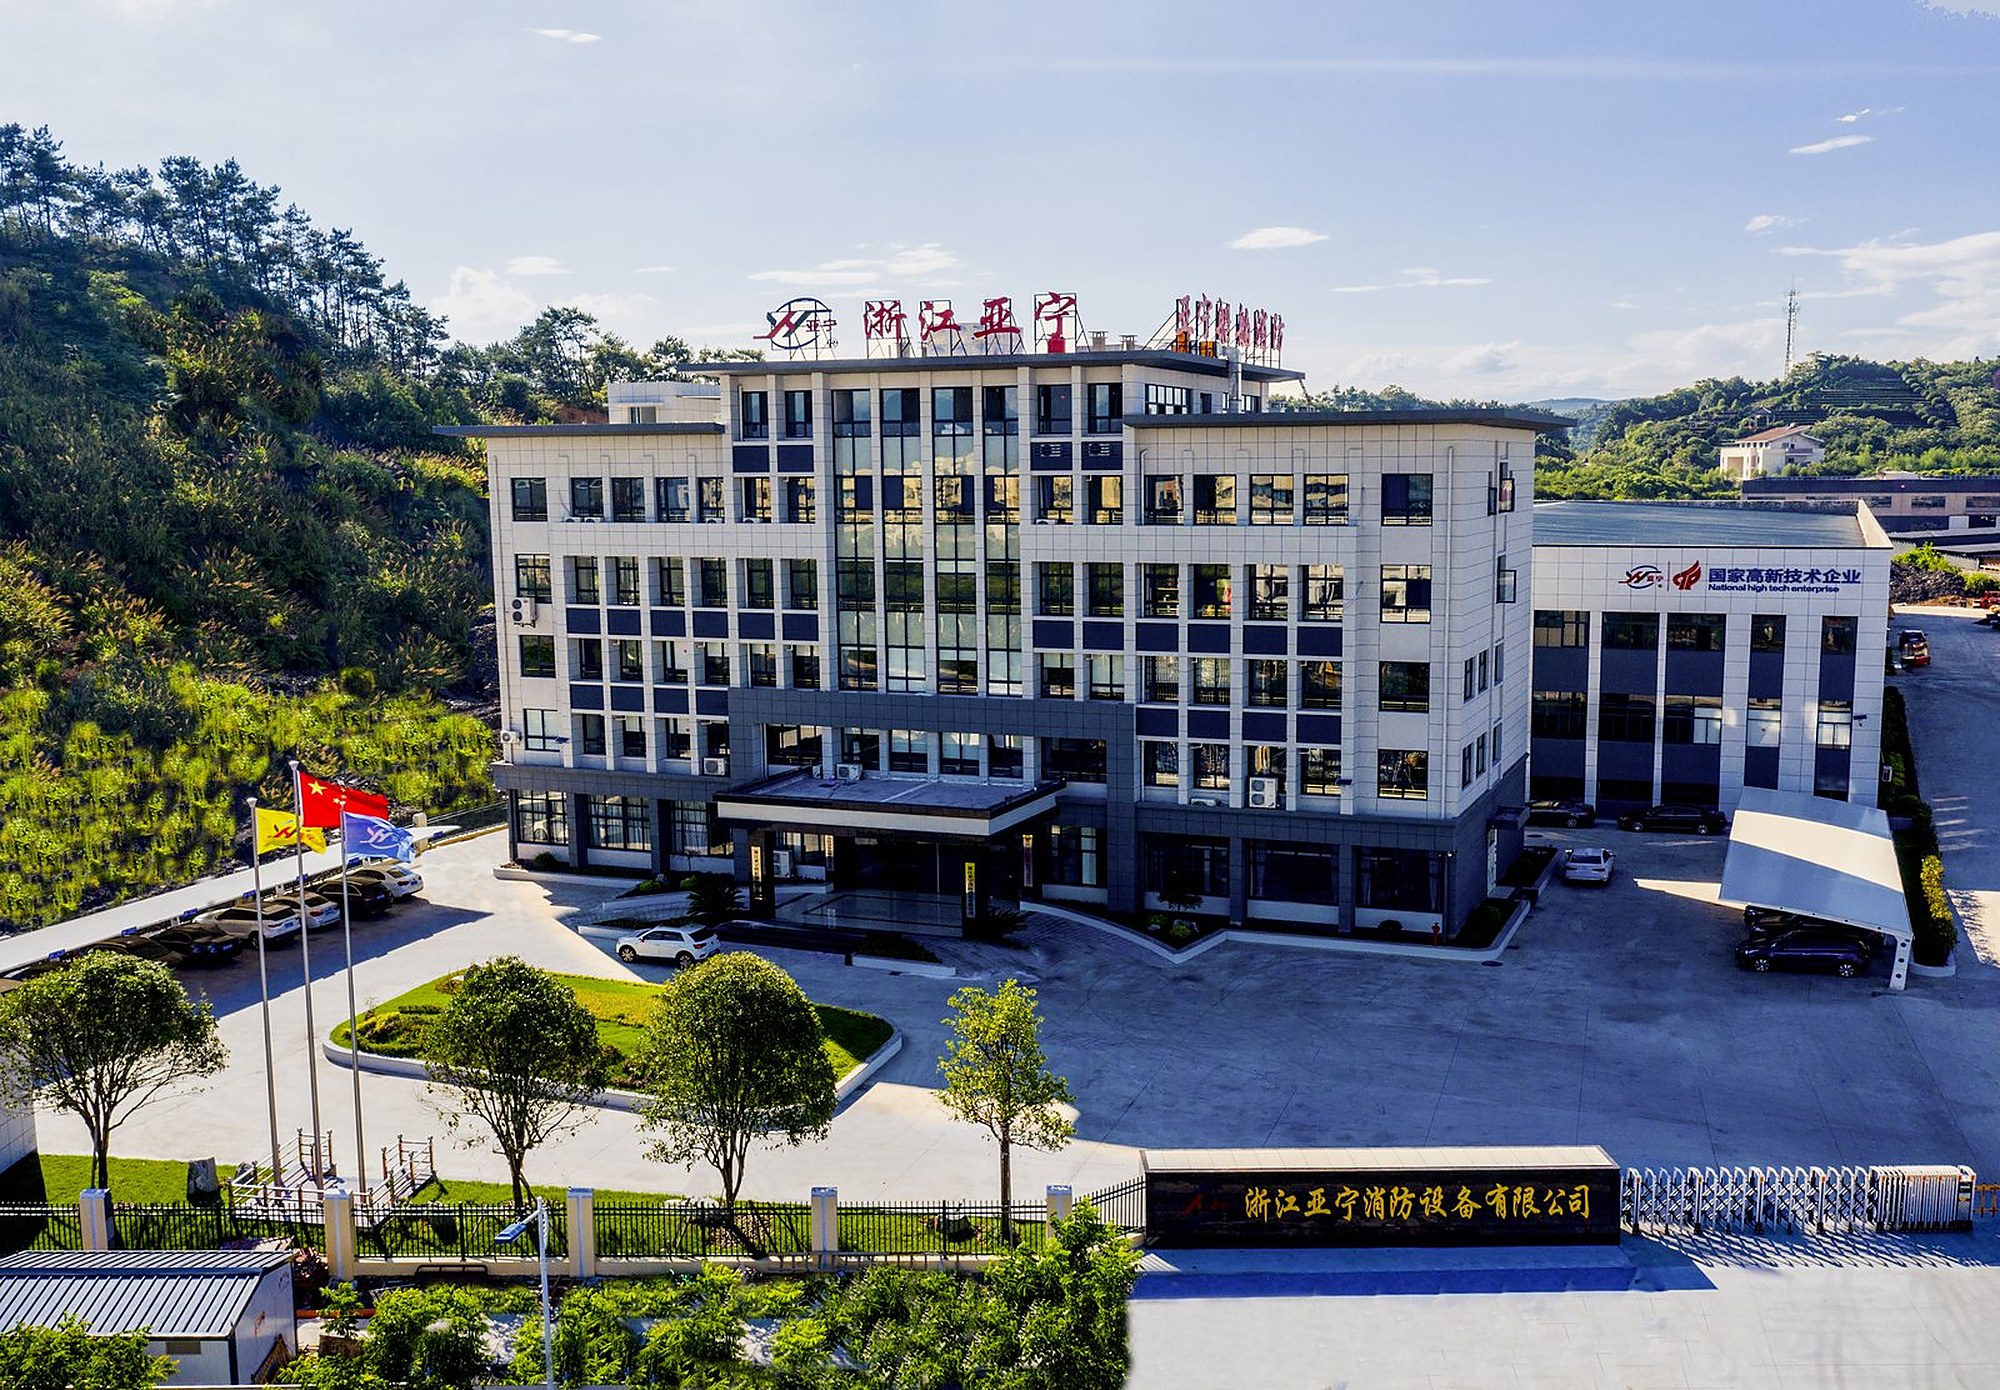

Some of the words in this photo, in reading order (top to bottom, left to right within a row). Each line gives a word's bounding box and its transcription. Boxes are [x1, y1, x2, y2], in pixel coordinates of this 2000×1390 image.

[863, 291, 1077, 343] 浙江亚宁
[1708, 568, 1861, 584] 国家高新技术企业
[1708, 583, 1747, 592] National
[1749, 584, 1767, 593] high
[1791, 585, 1840, 594] enterprise
[1245, 1183, 1590, 1224] 浙江亚宁消防设备有限公司
